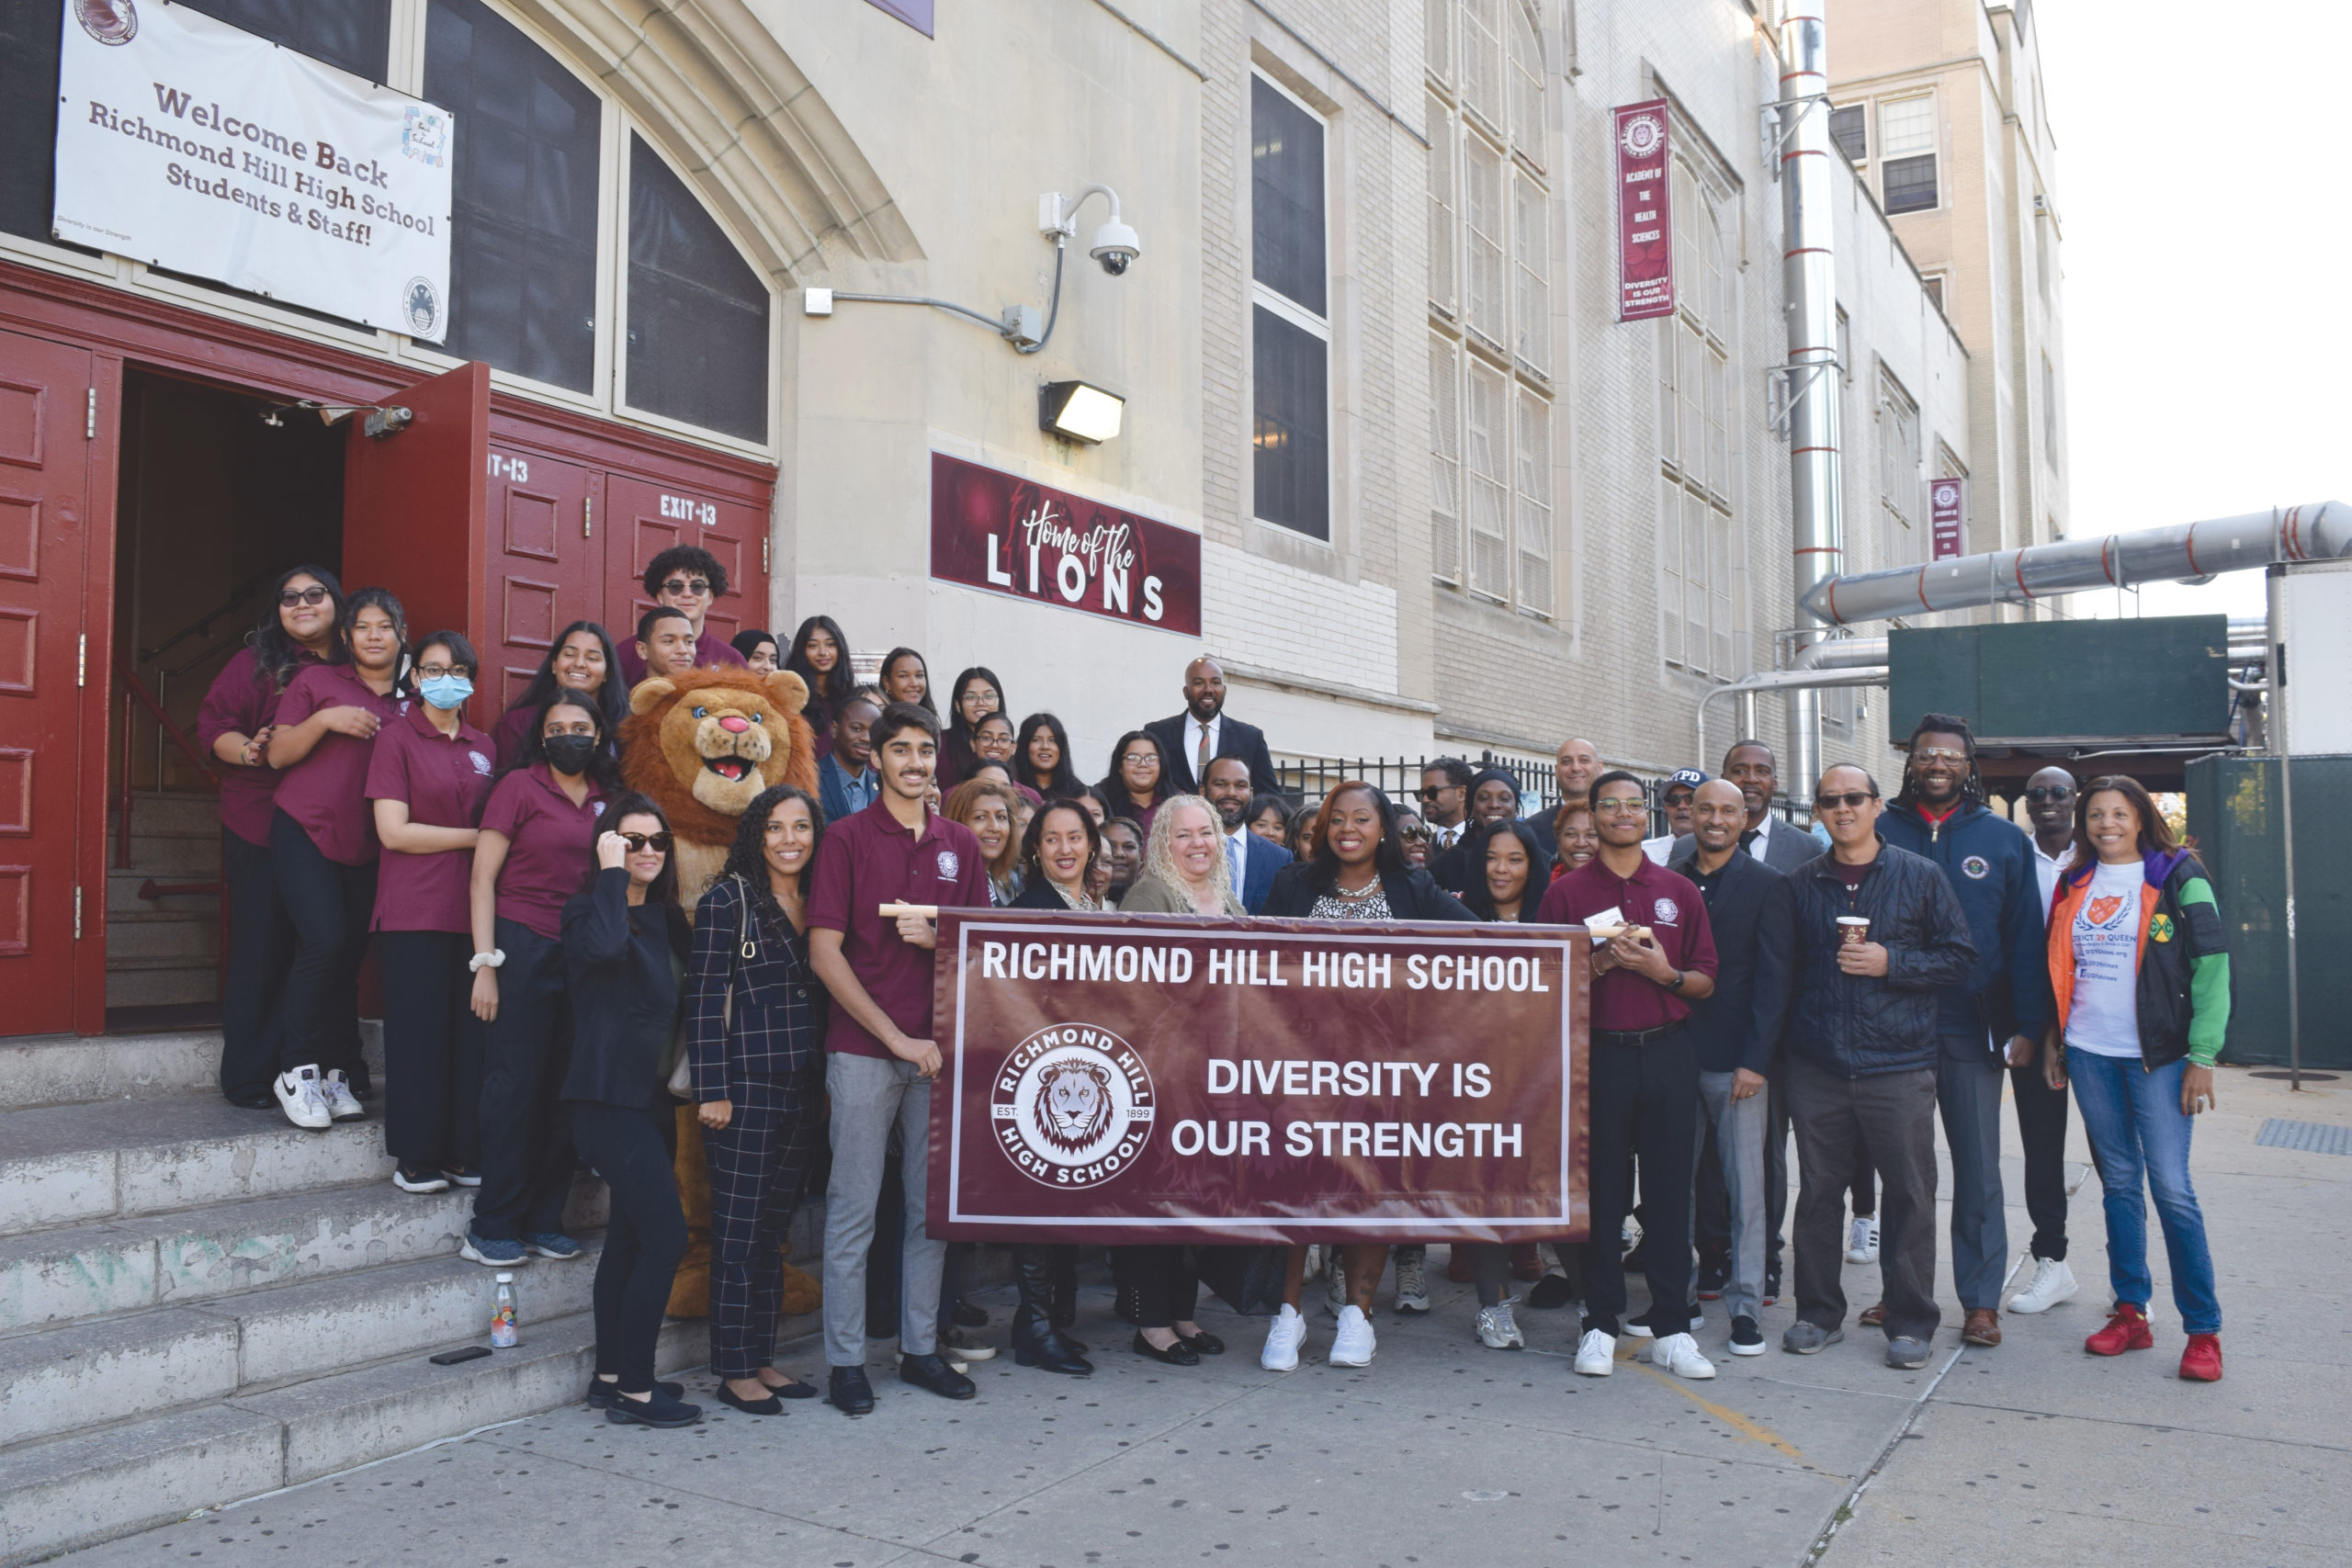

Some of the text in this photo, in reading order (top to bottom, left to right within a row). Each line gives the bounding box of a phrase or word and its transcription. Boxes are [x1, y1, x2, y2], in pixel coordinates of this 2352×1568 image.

[85, 25, 127, 45] HIGH SCHOOL
[153, 82, 388, 189] Welcome Back
[89, 100, 435, 237] Richmond Hill High School
[1625, 167, 1662, 183] ACADEMY OF
[166, 163, 371, 247] Students & Staff!
[1639, 190, 1651, 201] THE
[57, 215, 85, 229] Diversity
[105, 229, 131, 241] Strength
[1634, 209, 1657, 222] HEALTH
[1632, 229, 1660, 243] SCIENCES
[1624, 276, 1668, 289] DIVERSITY
[1643, 287, 1661, 297] OUR
[1624, 295, 1669, 307] STRENGTH
[488, 453, 528, 483] IT-13
[660, 493, 717, 526] EXIT-13
[1023, 500, 1136, 577] Home of the
[988, 533, 1164, 621] LIONS
[2072, 933, 2137, 942] TRICT 29 QUEEN
[982, 941, 1550, 992] RICHMOND HILL HIGH SCHOOL
[1000, 1028, 1150, 1105] RICHMOND HILL
[1207, 1058, 1492, 1099] DIVERSITY IS
[997, 1107, 1019, 1117] EST.
[1125, 1109, 1150, 1119] 1899
[1171, 1119, 1522, 1158] OUR STRENGTH
[1001, 1126, 1145, 1184] HIGH SCHOOL
